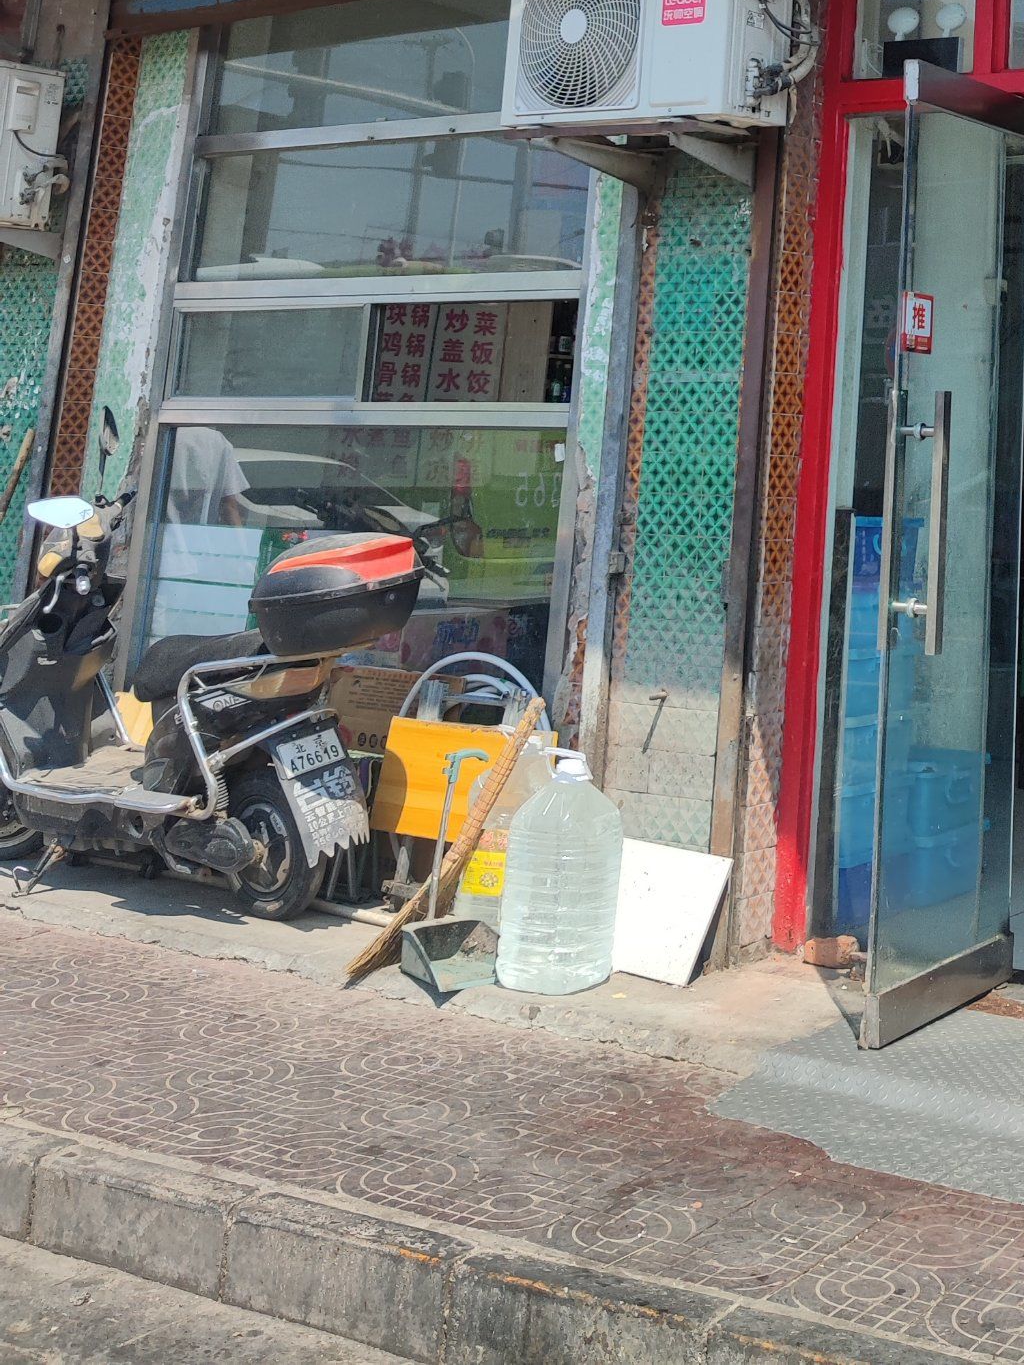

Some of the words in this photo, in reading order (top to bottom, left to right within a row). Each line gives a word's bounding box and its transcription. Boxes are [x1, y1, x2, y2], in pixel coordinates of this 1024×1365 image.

[443, 308, 499, 336] 炒菜
[912, 301, 926, 331] 推
[439, 338, 495, 365] 盖饭
[435, 368, 492, 395] 水饺
[294, 734, 328, 754] 北京
[289, 744, 340, 774] A76619
